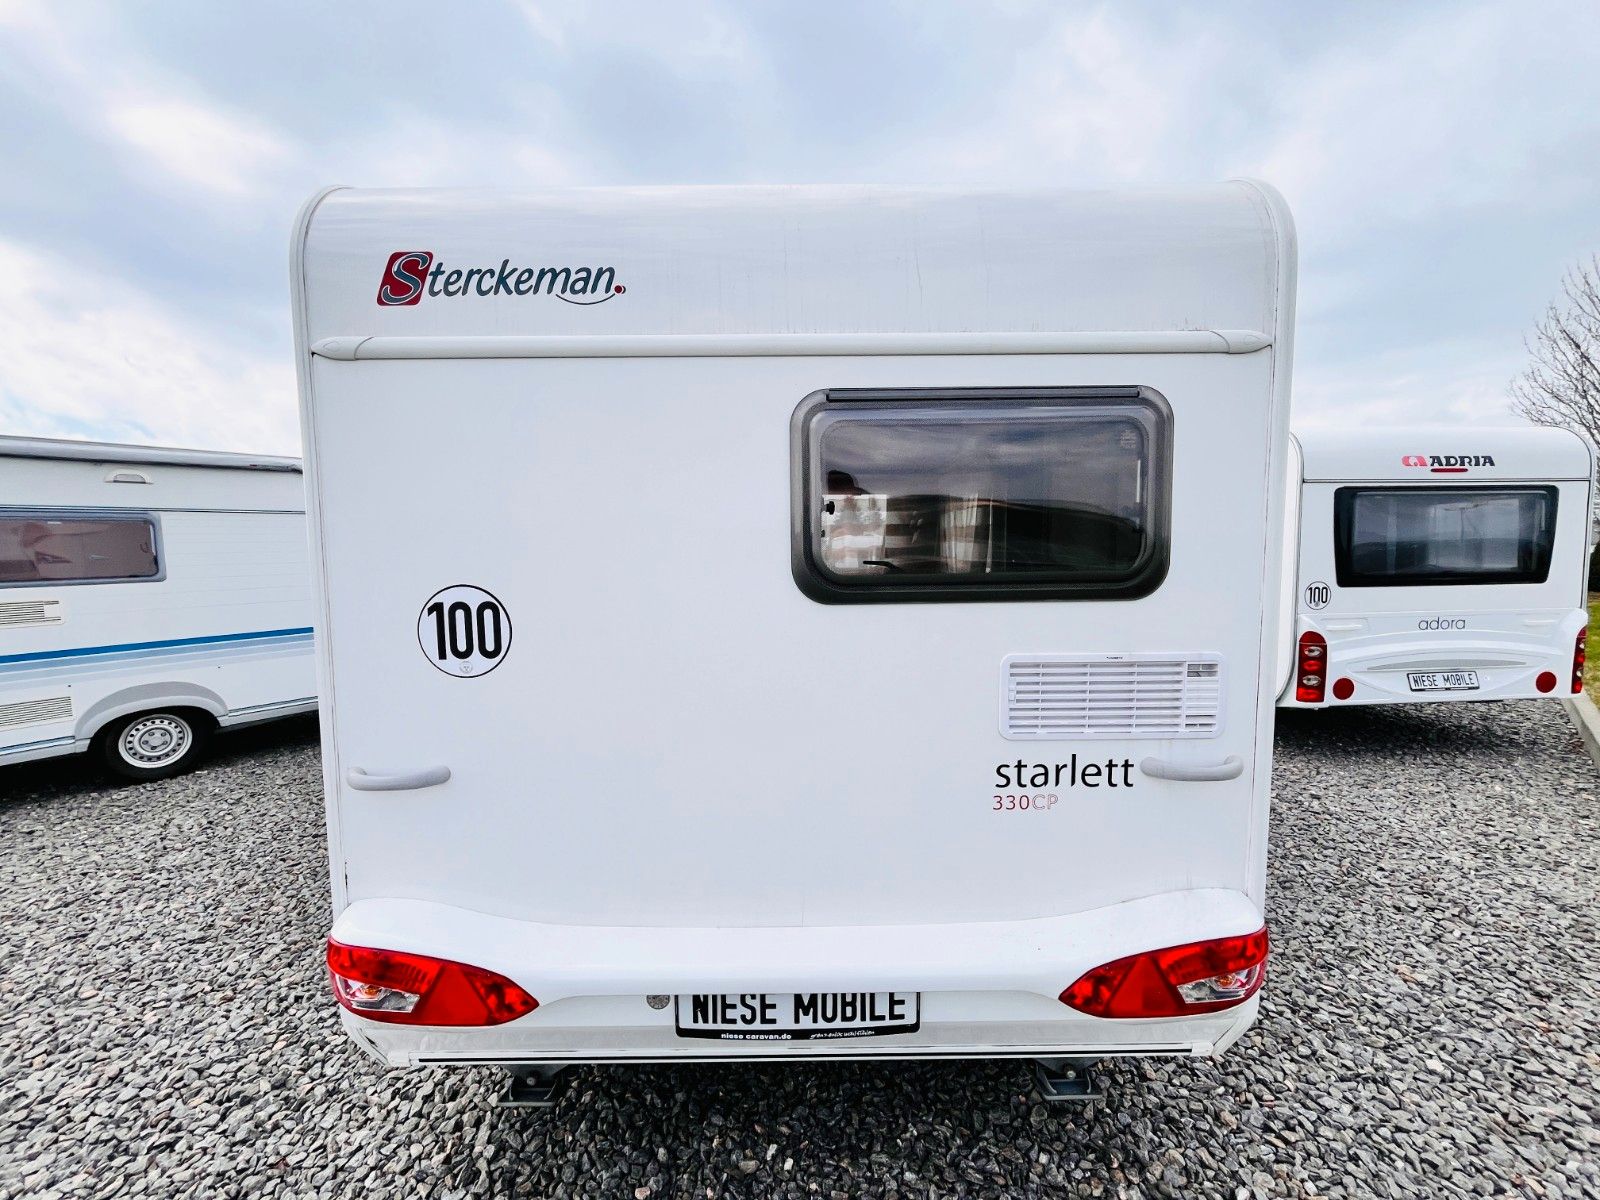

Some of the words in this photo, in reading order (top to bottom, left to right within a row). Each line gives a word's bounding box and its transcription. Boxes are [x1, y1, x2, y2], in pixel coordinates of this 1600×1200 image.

[1429, 455, 1495, 467] ADRIA
[1308, 586, 1328, 604] 100
[427, 600, 502, 660] 100
[1418, 617, 1466, 631] adora
[1412, 674, 1438, 687] NIESE
[1442, 673, 1475, 686] MOBILE
[995, 753, 1135, 788] starlett
[992, 794, 1059, 811] 330CP
[692, 993, 777, 1024] NIESE
[794, 991, 906, 1024] MOBILE
